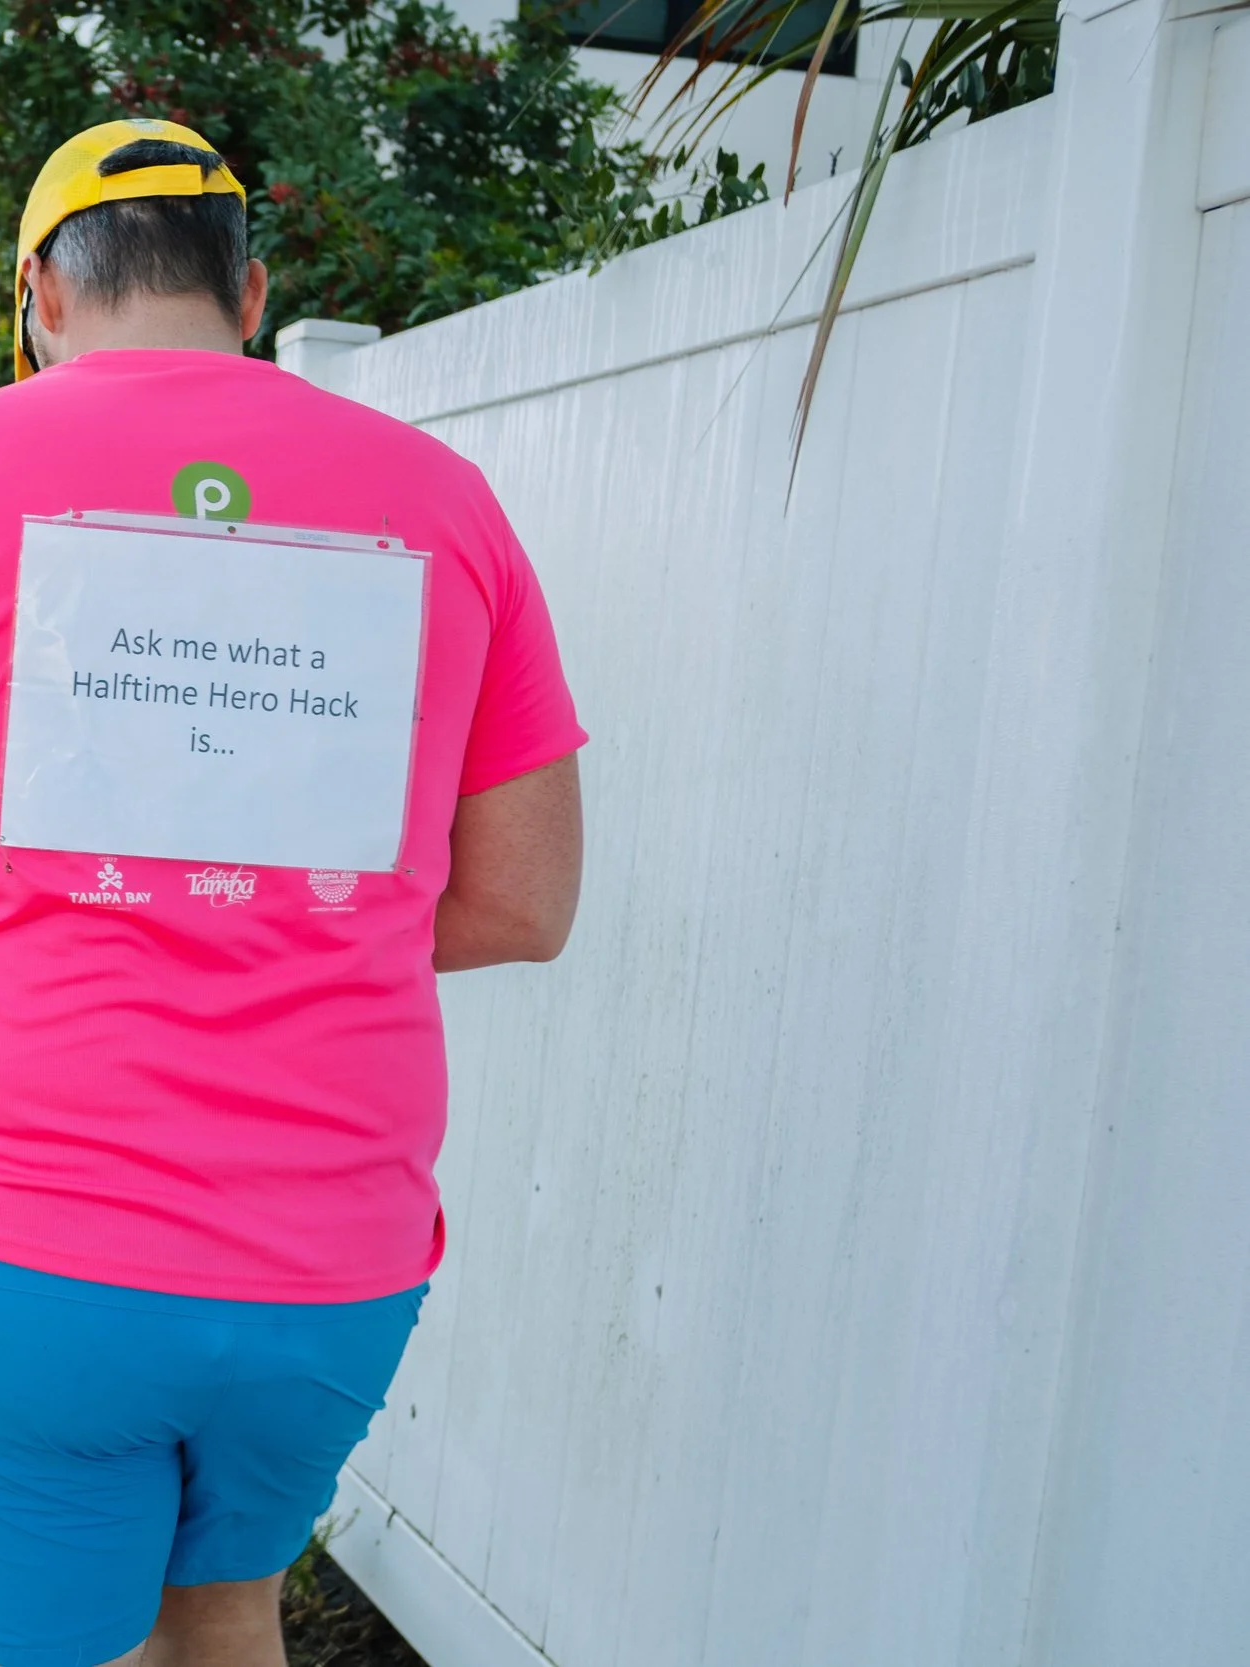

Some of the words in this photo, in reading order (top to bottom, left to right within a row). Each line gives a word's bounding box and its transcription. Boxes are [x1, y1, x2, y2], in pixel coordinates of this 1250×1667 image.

[110, 627, 162, 657] Ask
[173, 638, 218, 662] me
[228, 638, 301, 668] what
[310, 650, 327, 670] a
[72, 671, 198, 706] Halftime
[208, 682, 279, 713] Hero
[289, 688, 359, 719] Hack
[190, 727, 235, 756] is...
[185, 873, 256, 902] Tampa
[200, 867, 230, 880] City
[307, 873, 340, 881] TAMPA
[69, 892, 122, 904] TAMPA
[125, 891, 152, 904] BAY
